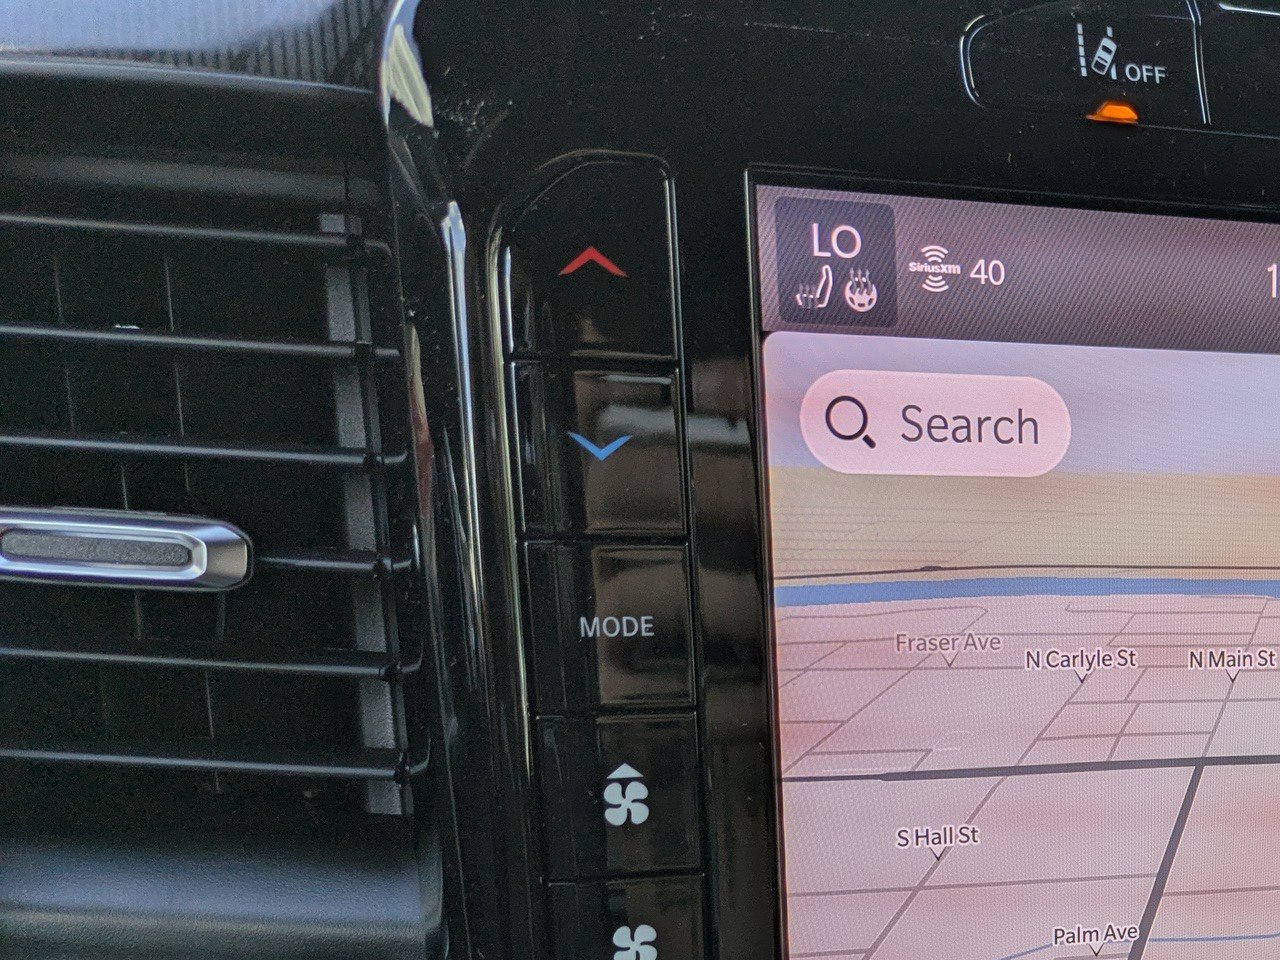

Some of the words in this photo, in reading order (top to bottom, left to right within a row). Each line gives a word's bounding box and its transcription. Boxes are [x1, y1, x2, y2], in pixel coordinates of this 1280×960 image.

[1125, 63, 1167, 85] OFF
[811, 222, 863, 259] LO
[969, 258, 1006, 286] 40
[900, 403, 1040, 446] Search
[579, 615, 656, 639] MODE
[896, 633, 959, 653] Fraser
[963, 633, 1002, 652] Ave
[1026, 650, 1042, 669] N
[1045, 649, 1113, 671] Carlyle
[1116, 649, 1137, 668] St
[1189, 650, 1203, 669] N
[1207, 650, 1253, 668] Main
[1256, 649, 1276, 668] St
[896, 828, 909, 848] S
[914, 827, 954, 847] Hall
[957, 825, 979, 845] St
[1053, 925, 1099, 946] Palm
[1102, 923, 1139, 942] Ave
